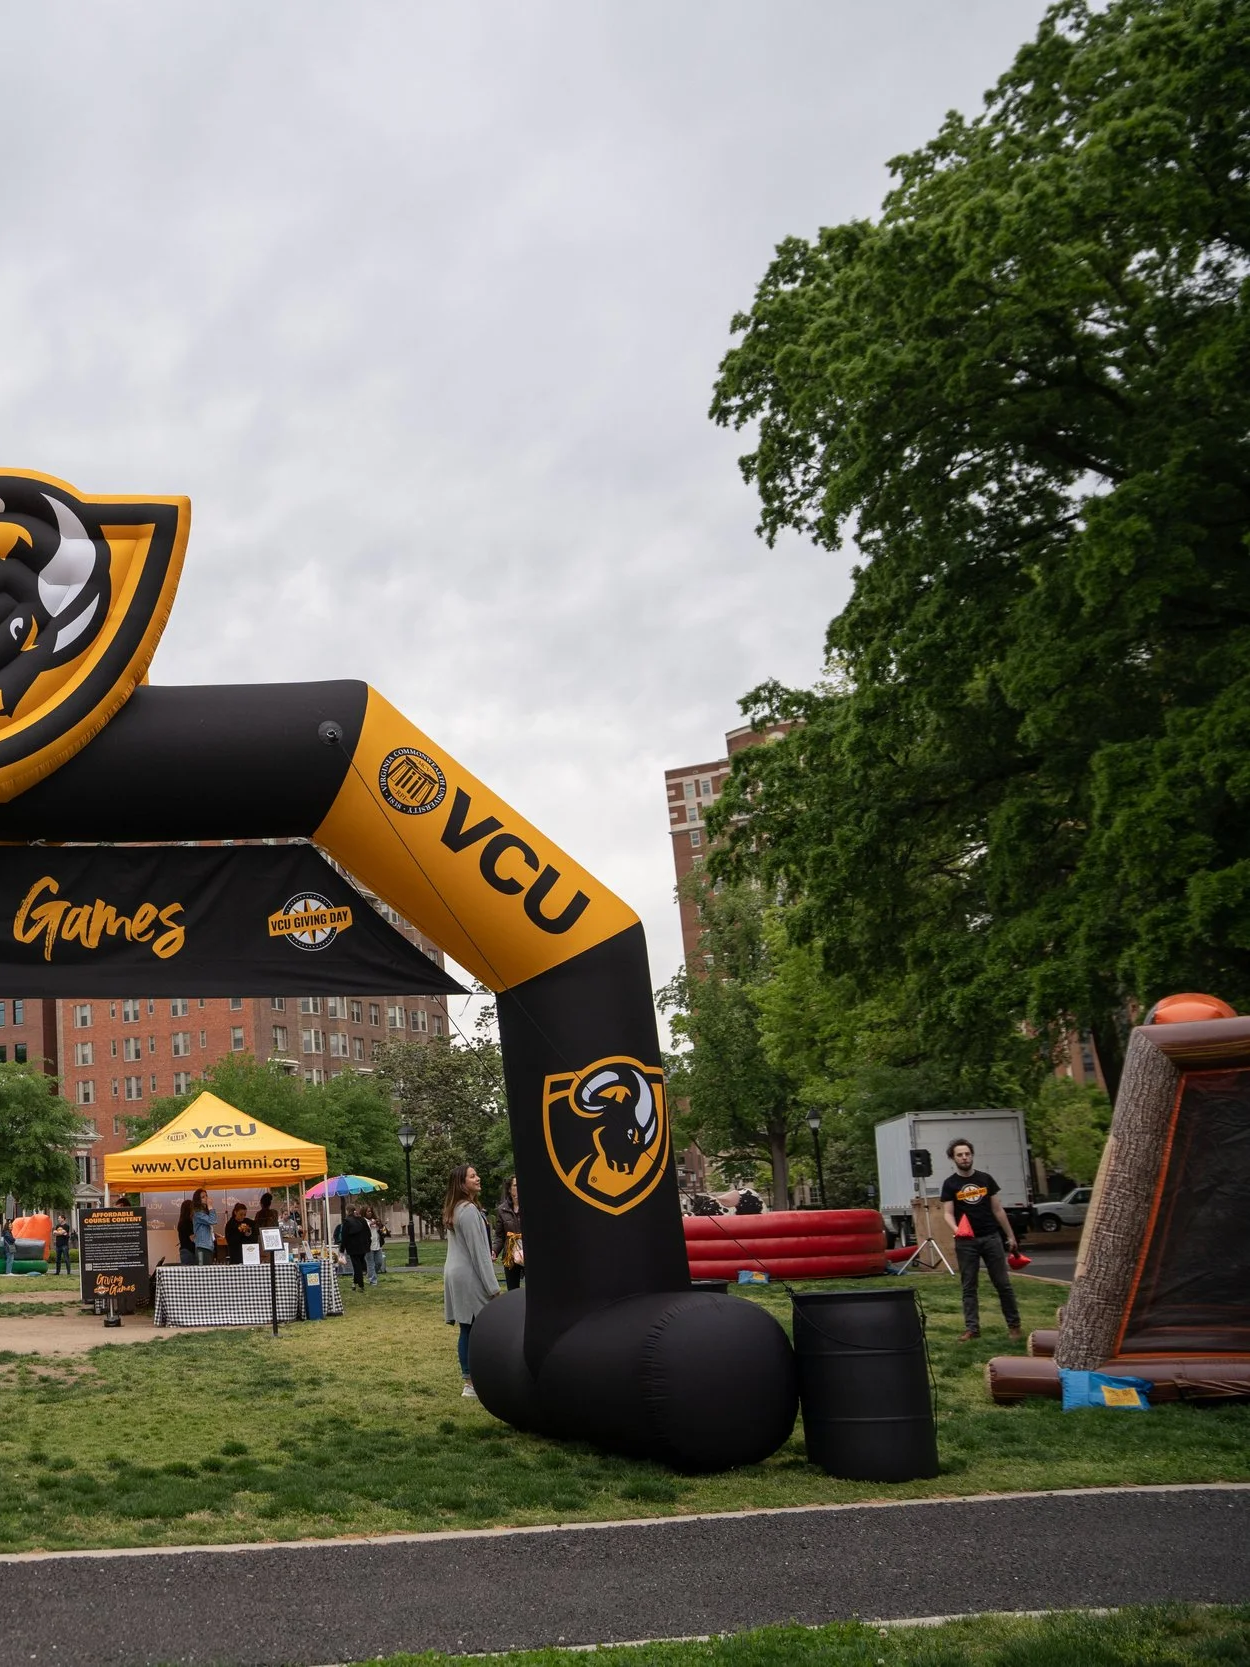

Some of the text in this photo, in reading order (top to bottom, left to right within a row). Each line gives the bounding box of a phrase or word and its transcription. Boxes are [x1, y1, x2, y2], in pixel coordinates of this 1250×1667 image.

[380, 748, 446, 814] VIRGINIA COMMONWEALTH UNIVERSITY
[440, 786, 591, 934] VCU
[12, 875, 186, 962] Games
[271, 910, 348, 931] VCU GIVING DAY
[190, 1122, 257, 1139] VCU
[131, 1155, 301, 1174] www.VCUalumni.org
[96, 1273, 124, 1287] Giving
[109, 1284, 136, 1296] Games
